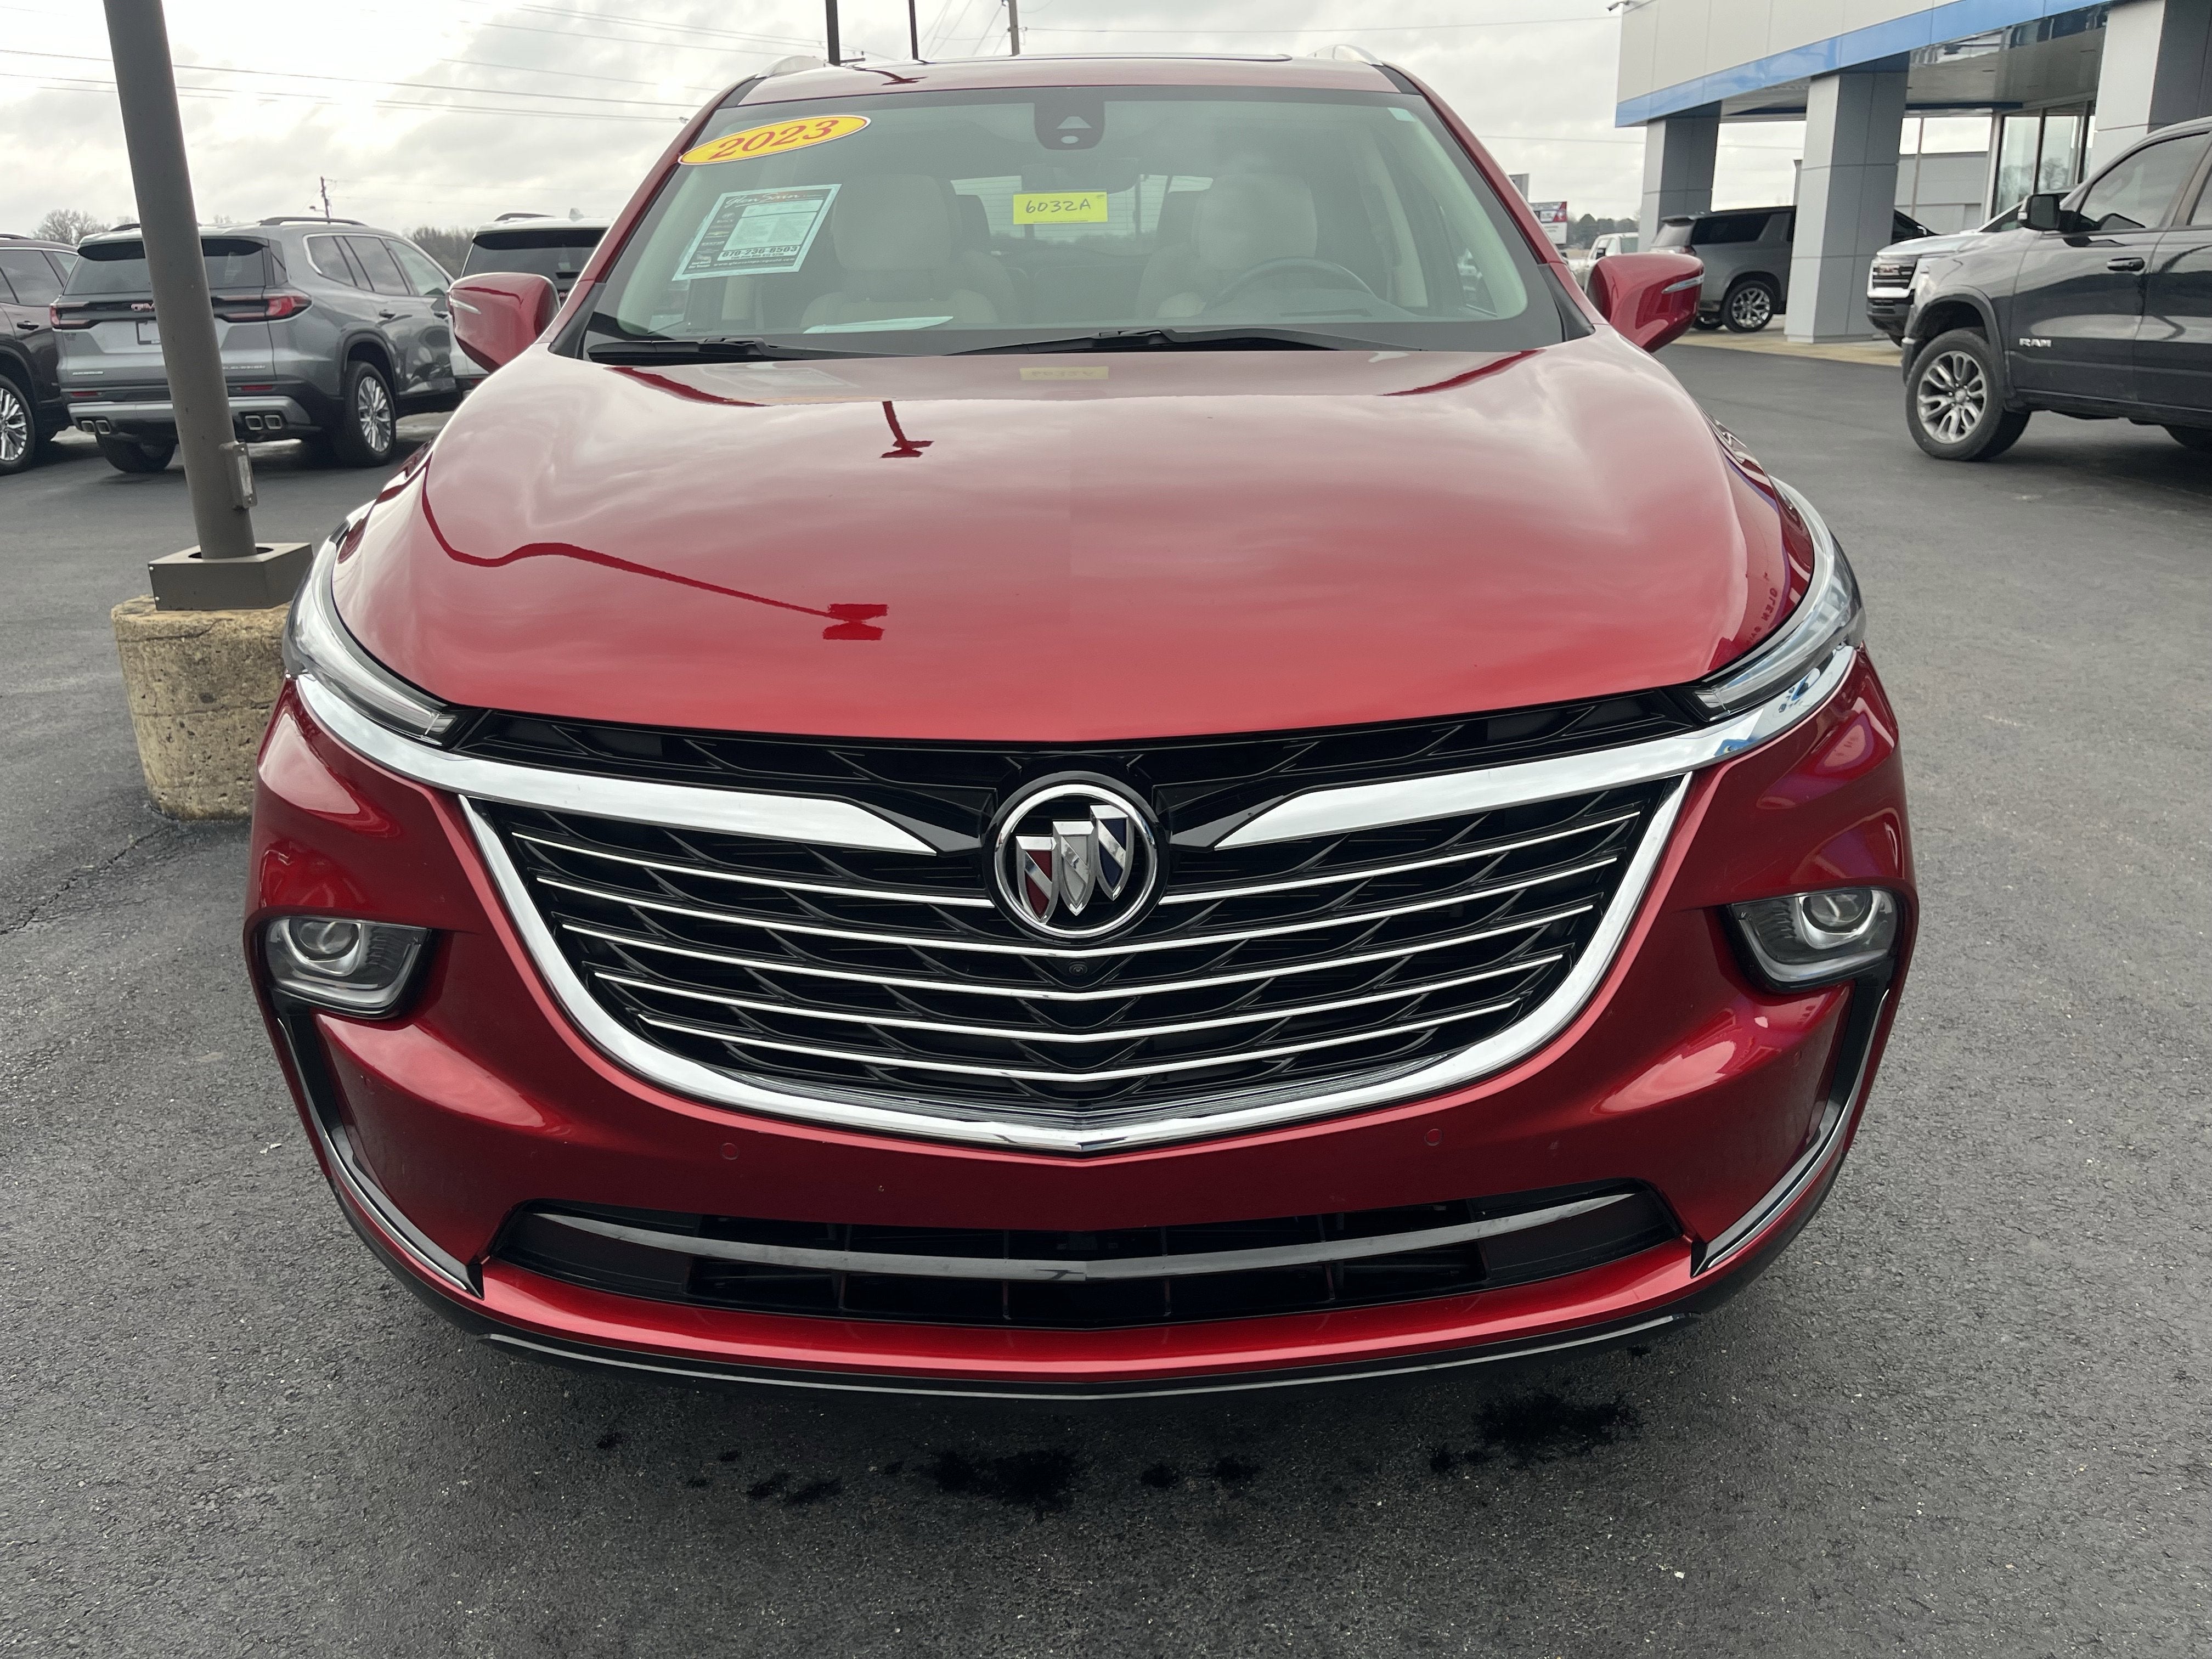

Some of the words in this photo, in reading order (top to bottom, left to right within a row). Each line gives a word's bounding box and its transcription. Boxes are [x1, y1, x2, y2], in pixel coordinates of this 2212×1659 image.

[708, 120, 839, 160] 2023
[1025, 198, 1091, 213] 6032A
[2019, 337, 2052, 347] RAM
